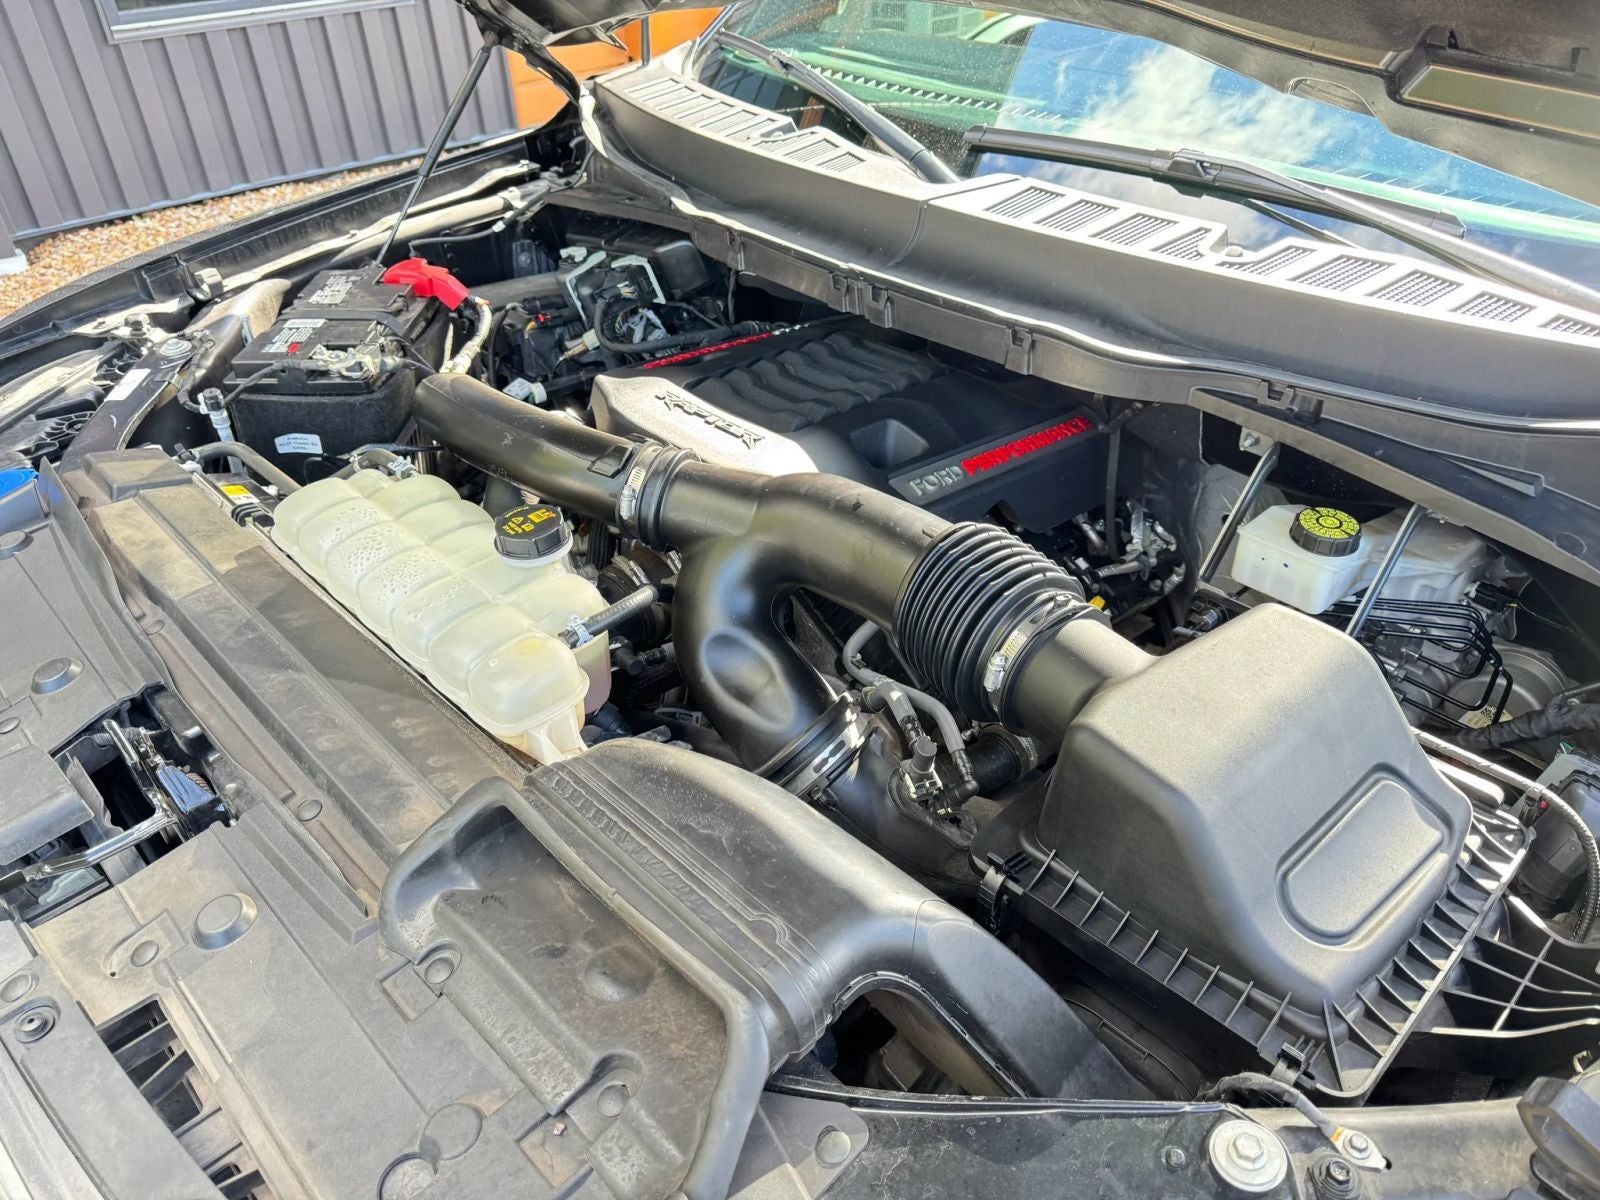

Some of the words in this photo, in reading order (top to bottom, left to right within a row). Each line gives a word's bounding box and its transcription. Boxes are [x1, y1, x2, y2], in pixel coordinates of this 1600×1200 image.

[654, 390, 766, 450] RAPTOR
[909, 465, 965, 496] FORD
[961, 415, 1093, 477] PERFORMANCE
